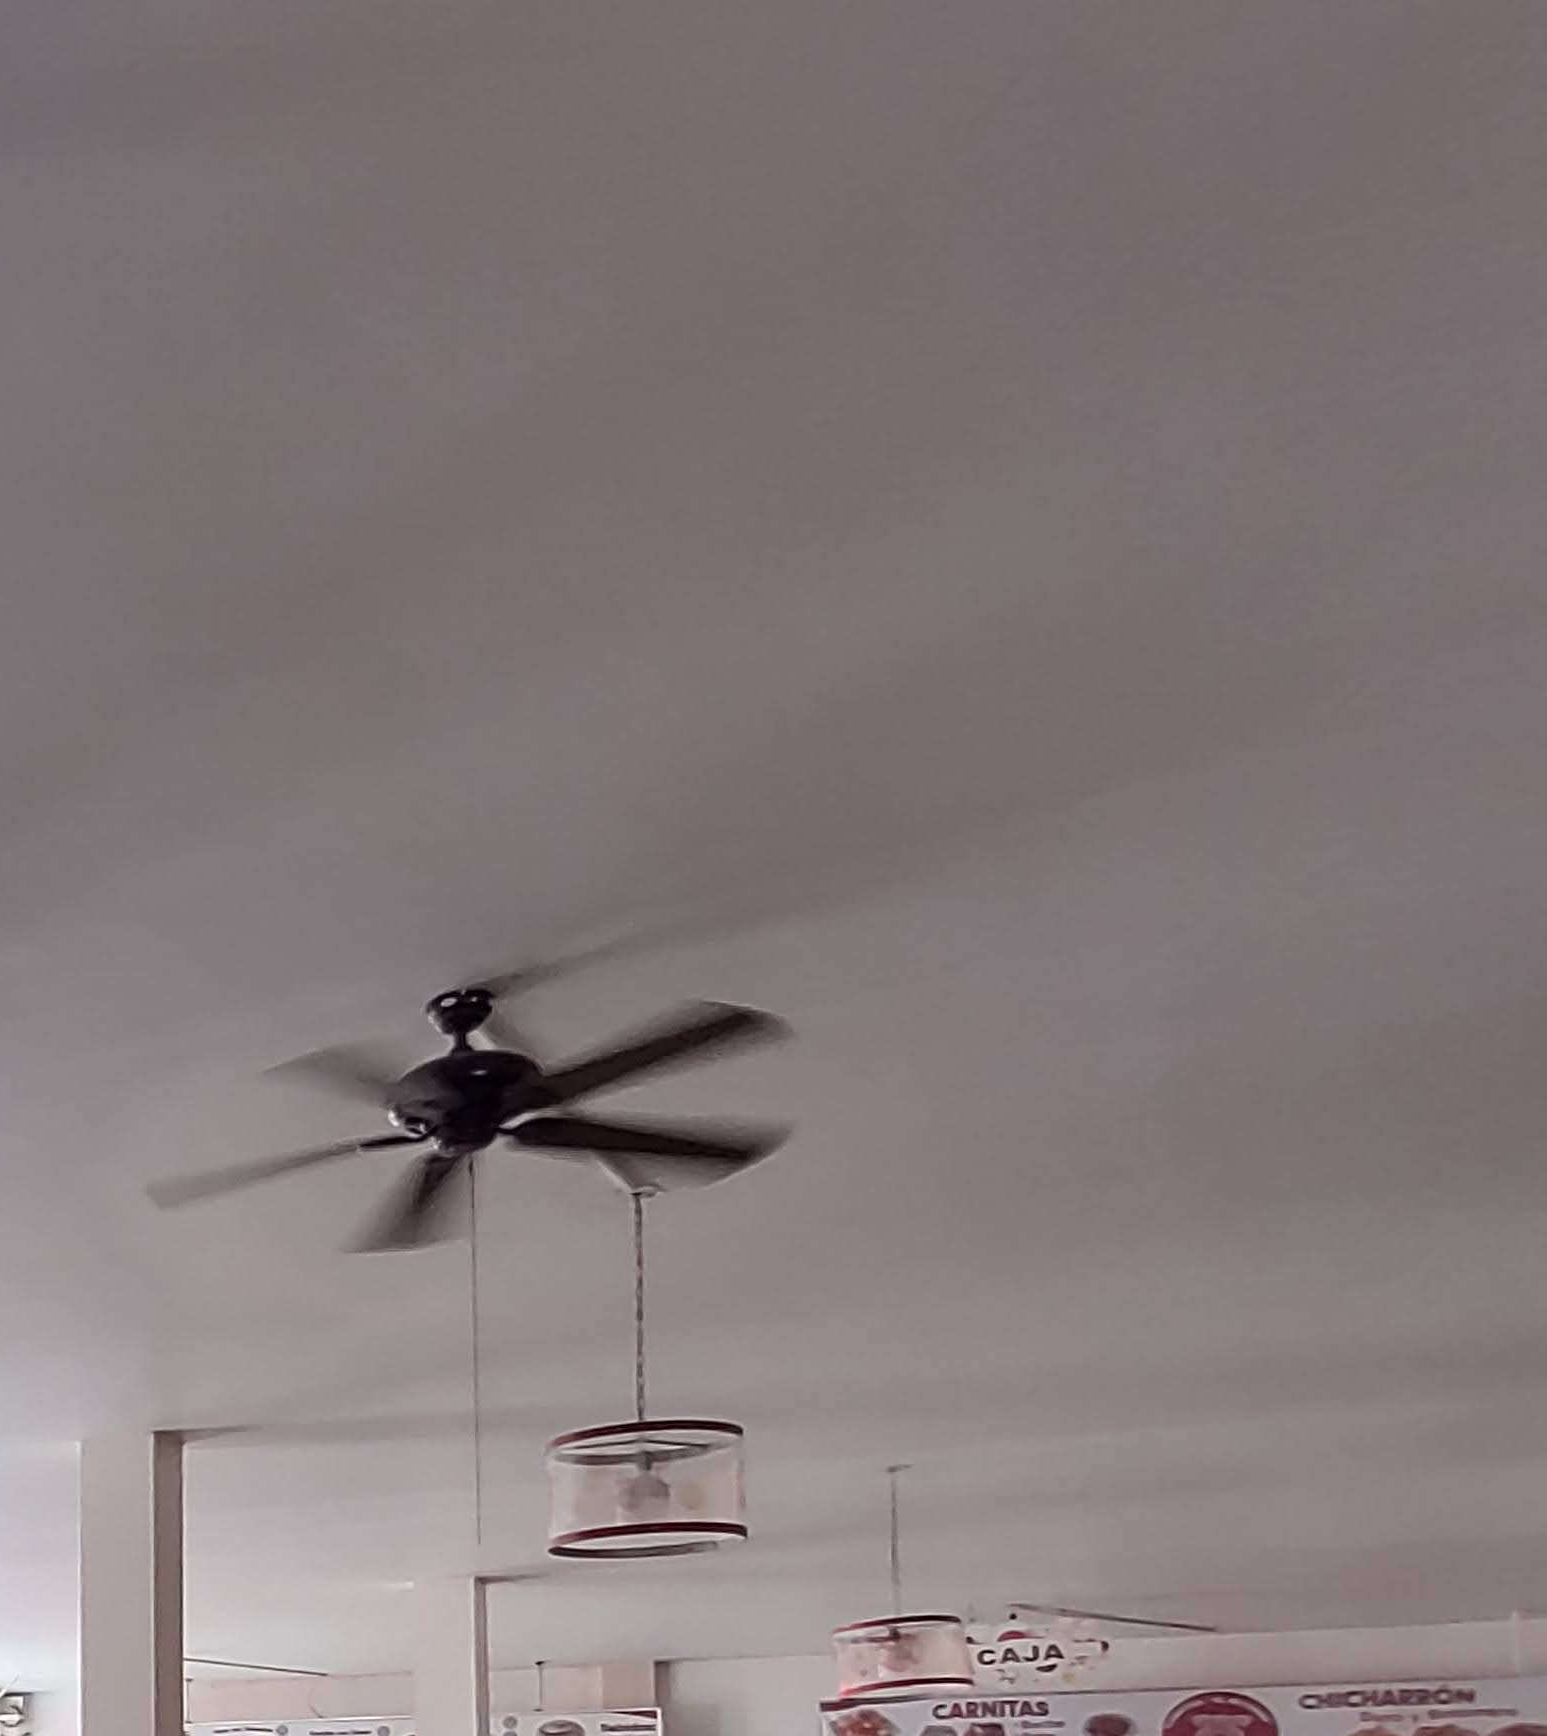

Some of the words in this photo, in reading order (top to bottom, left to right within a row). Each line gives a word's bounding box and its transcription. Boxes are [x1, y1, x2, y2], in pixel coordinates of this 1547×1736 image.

[976, 1643, 1065, 1666] CAJA
[1298, 1685, 1477, 1710] CHICHARRÓN
[931, 1700, 1050, 1720] CARNITAS
